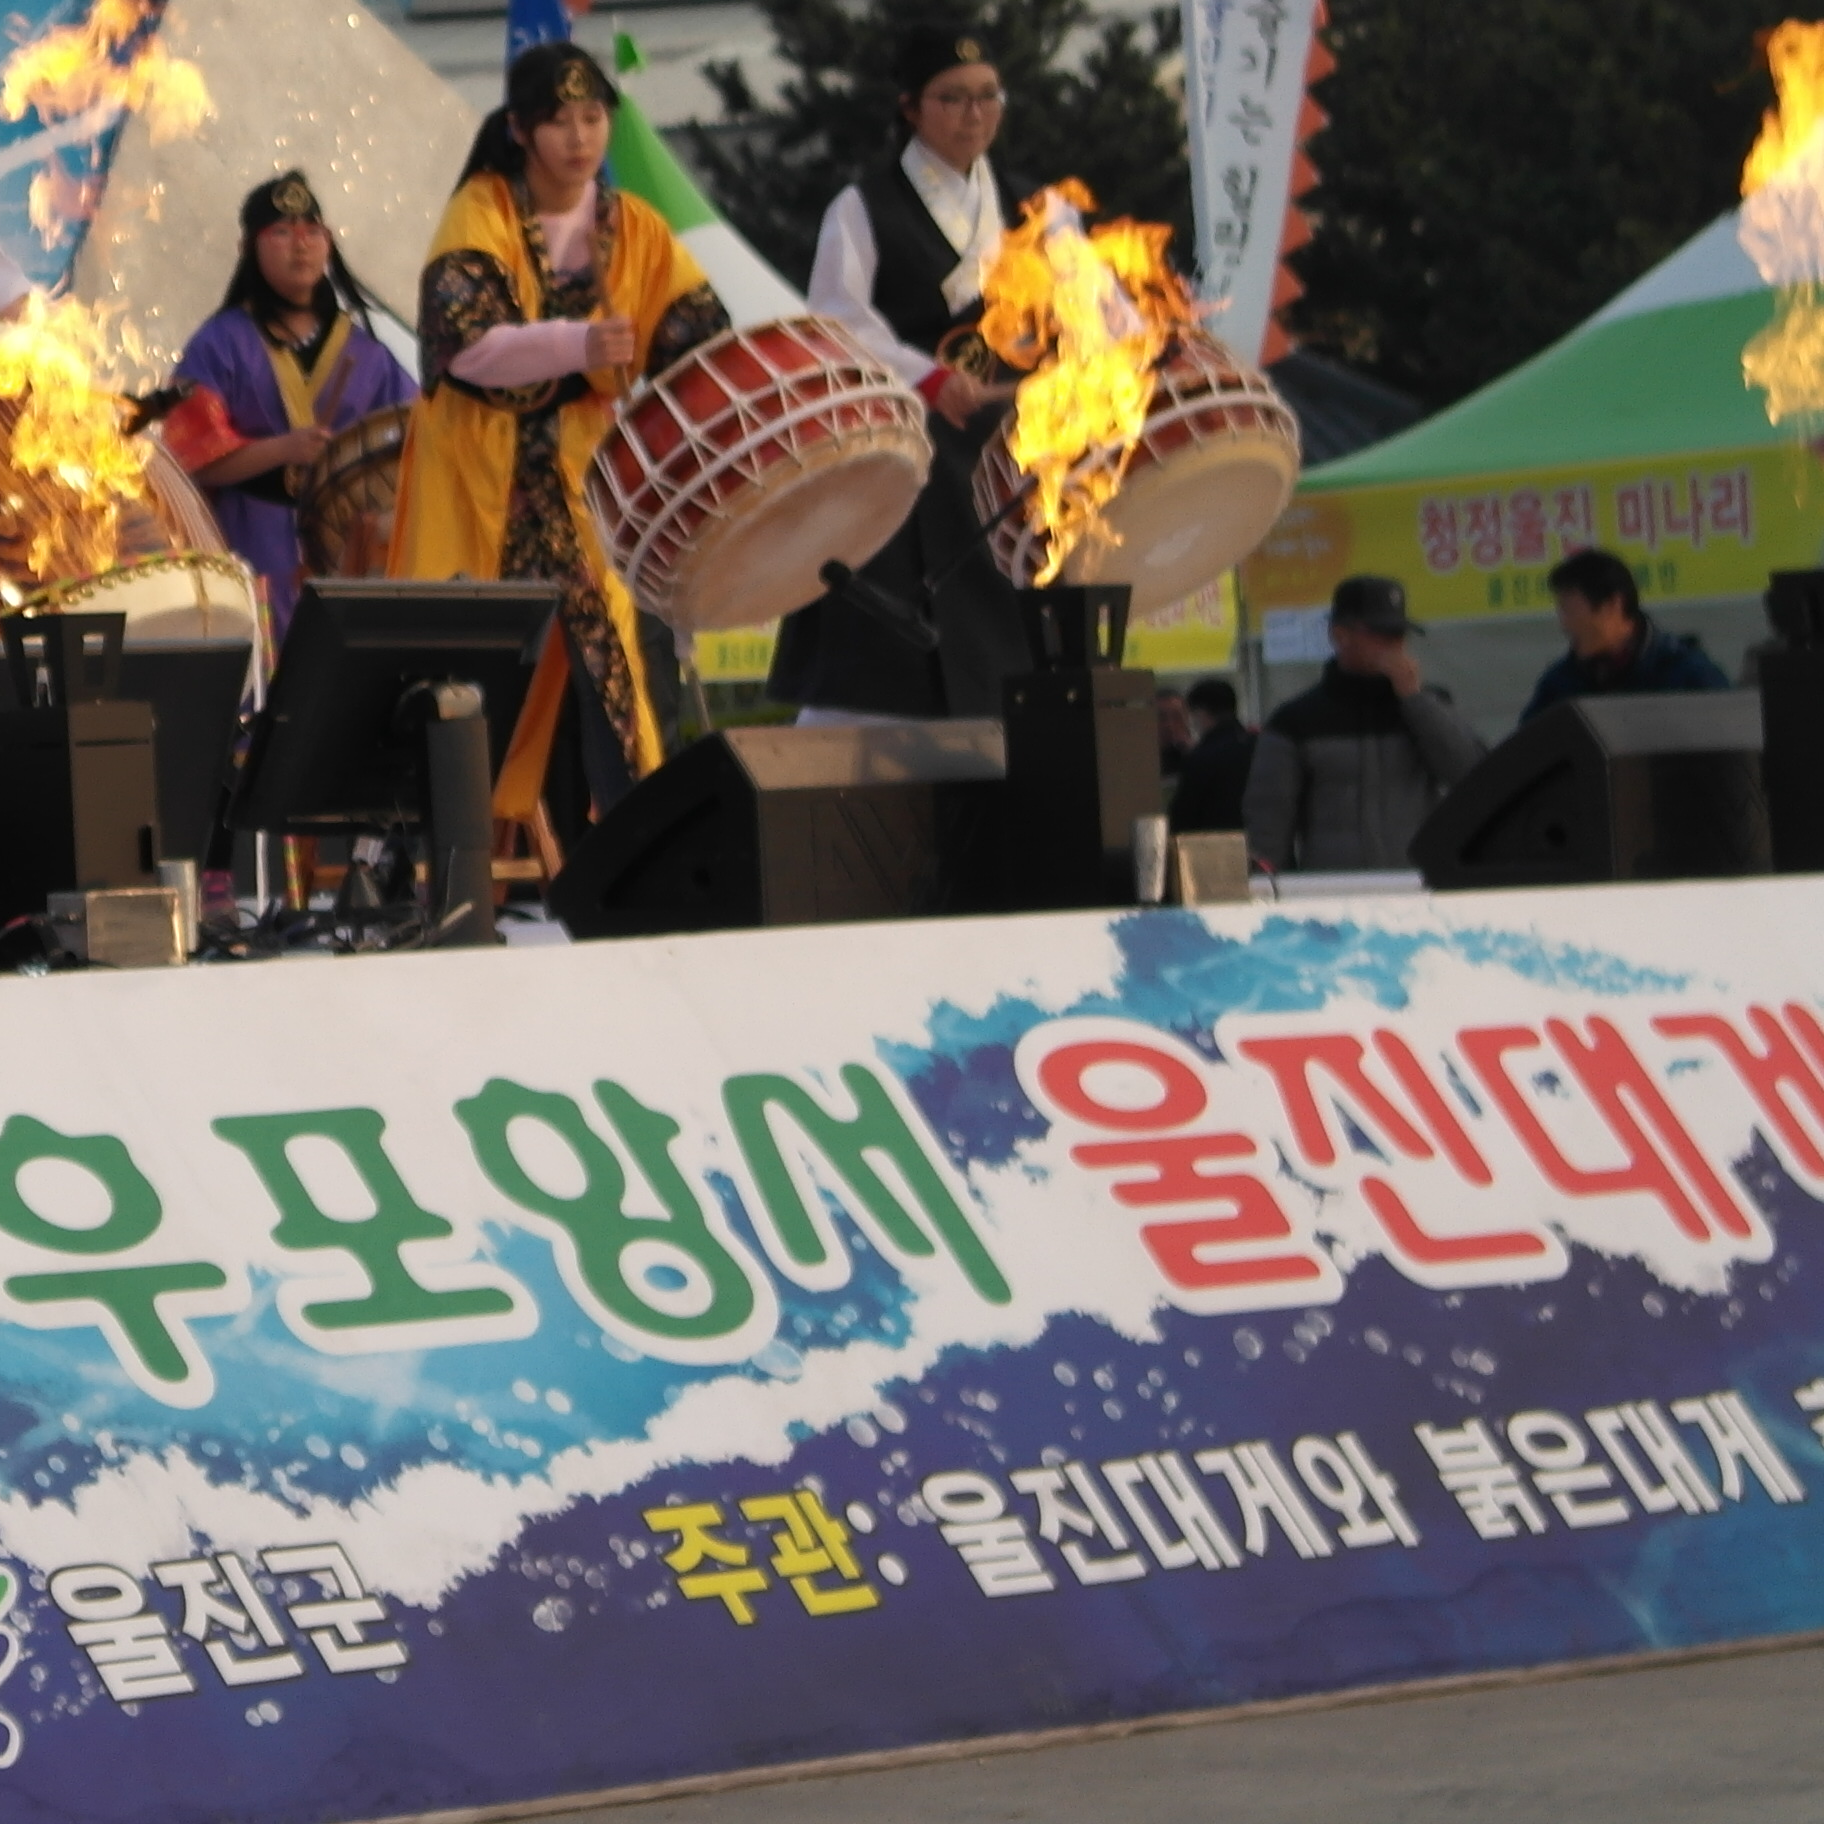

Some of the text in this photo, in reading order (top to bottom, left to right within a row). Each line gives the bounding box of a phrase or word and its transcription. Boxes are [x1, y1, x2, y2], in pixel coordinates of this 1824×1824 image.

[1420, 485, 1594, 571] 청정울진
[1616, 469, 1750, 549] 미나리
[1037, 1000, 1824, 1290] 울진대게
[920, 1431, 1421, 1597] 울진대게와
[1413, 1391, 1806, 1541] 붉은대게
[47, 1541, 408, 1705] 울진군
